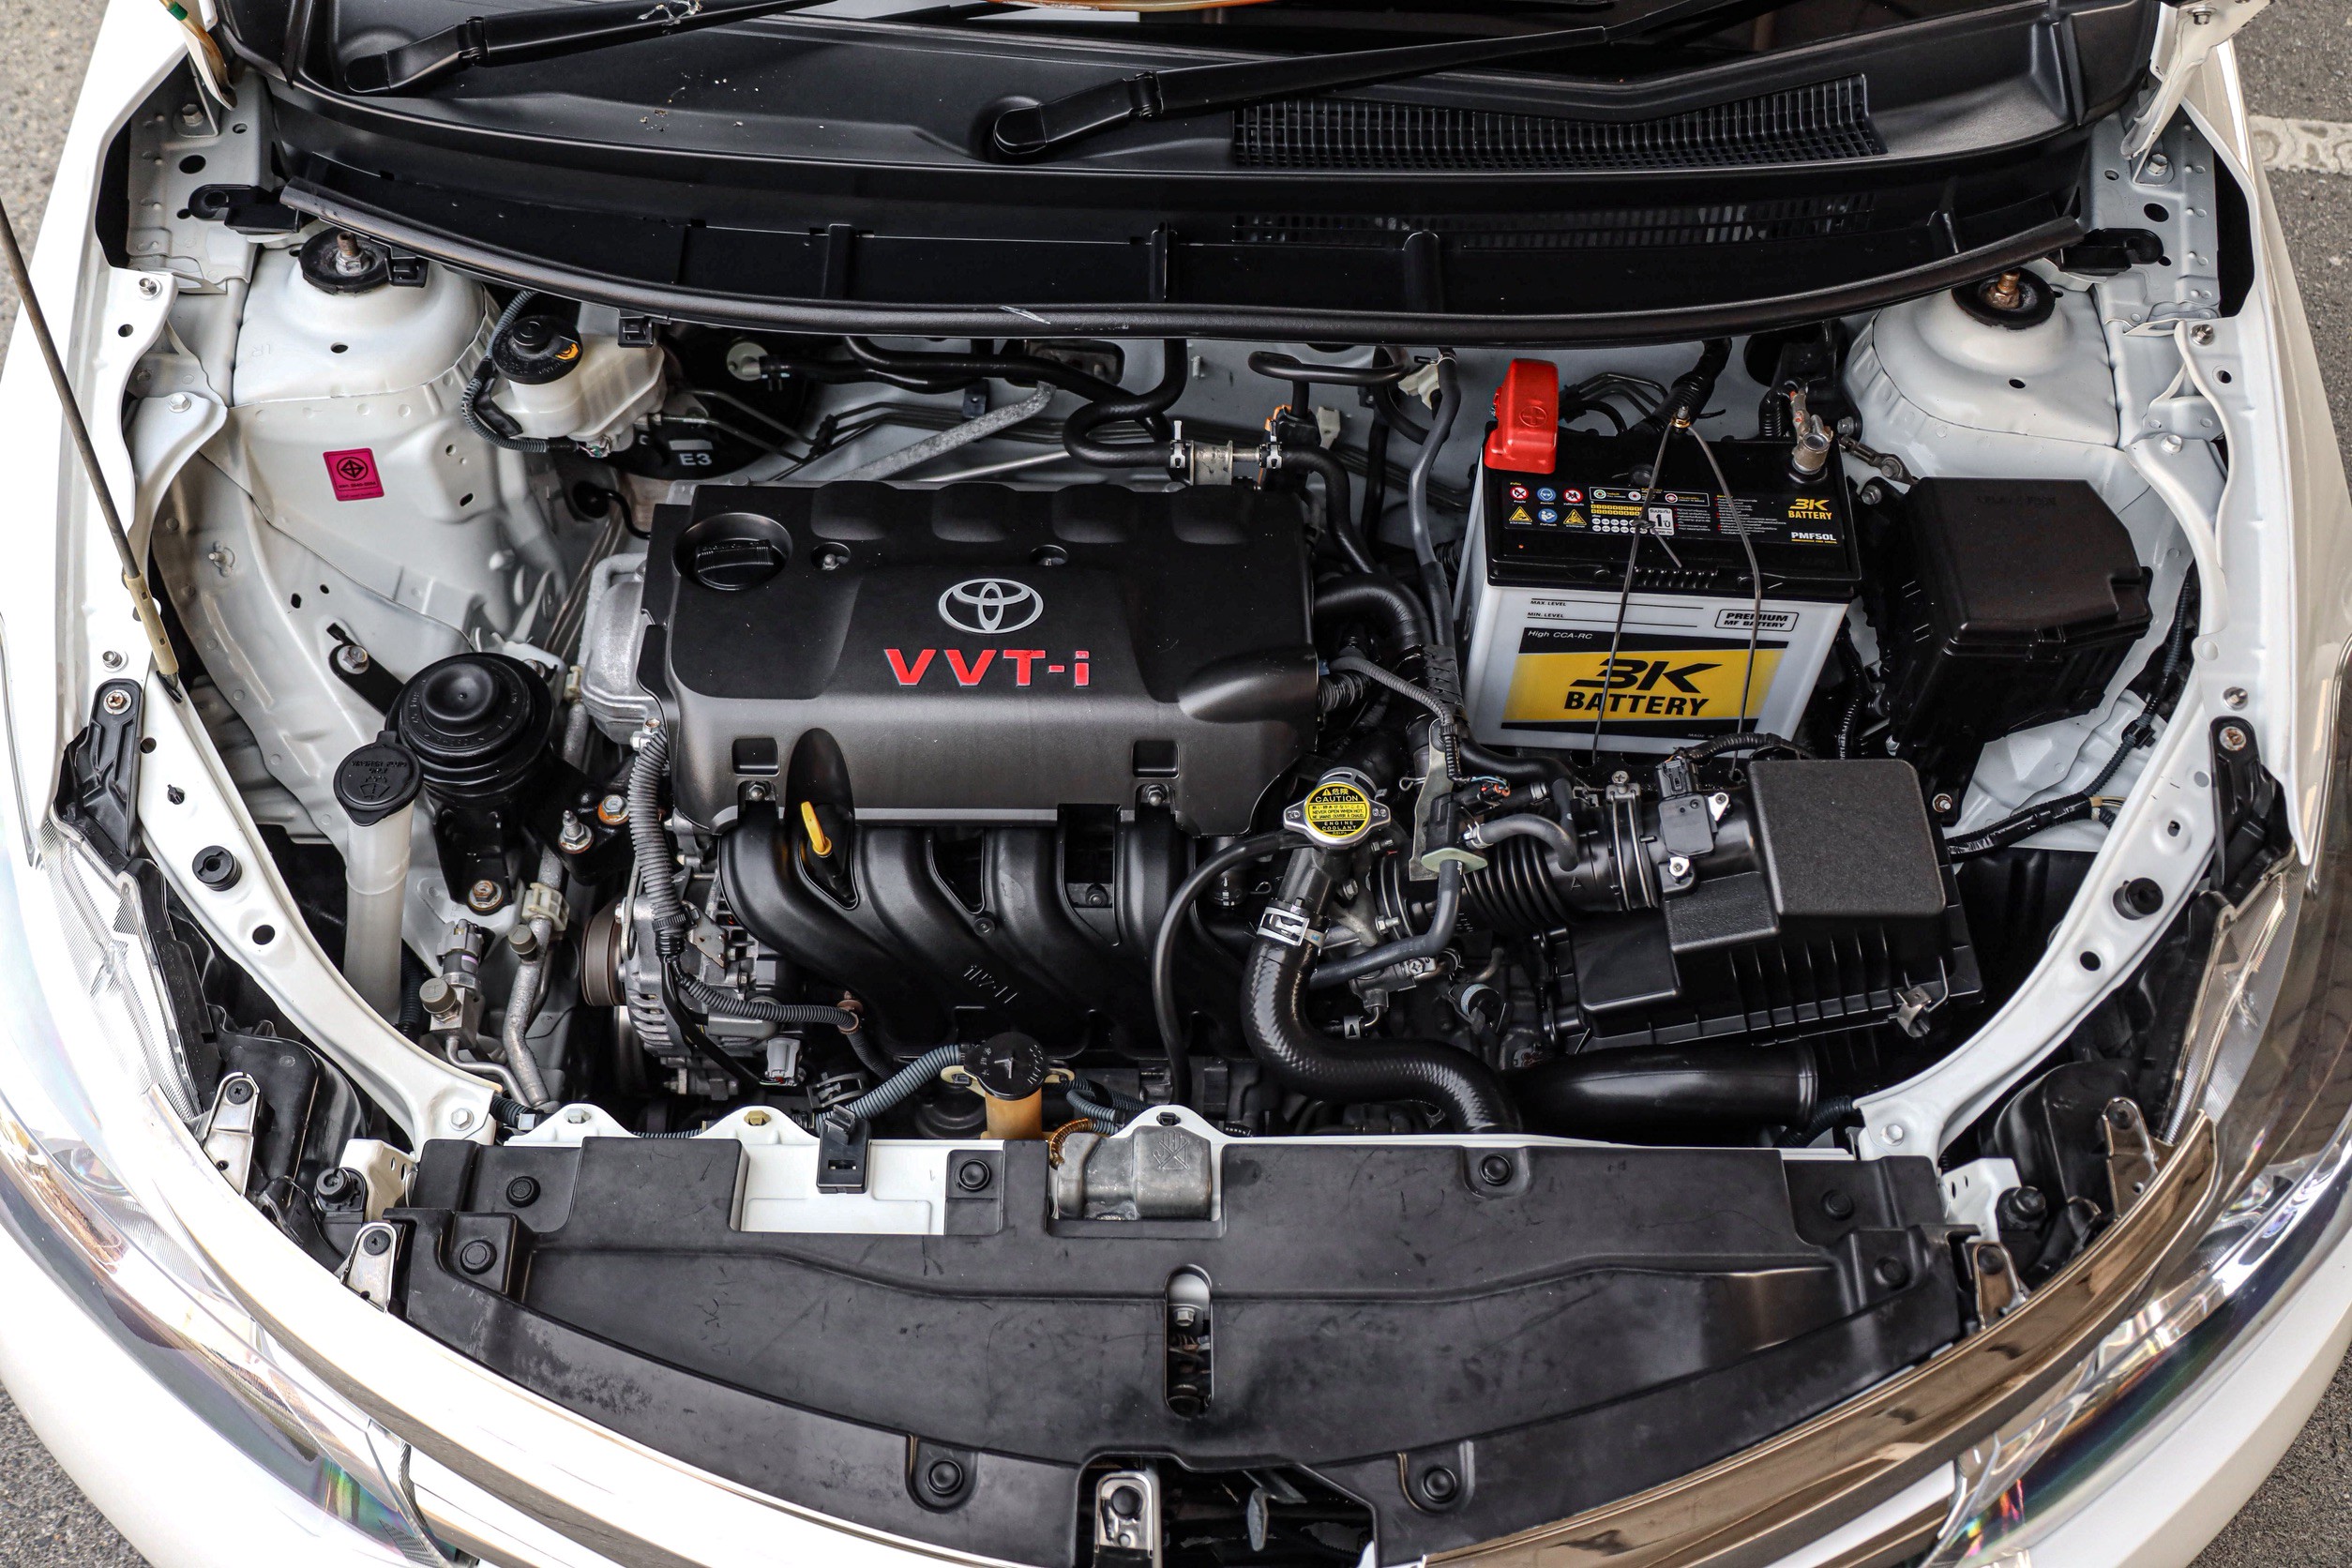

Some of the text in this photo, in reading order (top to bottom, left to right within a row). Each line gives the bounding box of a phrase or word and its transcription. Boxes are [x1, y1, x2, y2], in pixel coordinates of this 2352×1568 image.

[679, 453, 713, 466] E3
[1789, 498, 1830, 511] 3K
[1787, 510, 1832, 520] BATTERY
[1553, 631, 1593, 640] CCA-RC
[883, 648, 1090, 687] VVT-i
[1569, 658, 1724, 693] 3K
[1563, 691, 1710, 716] BATTERY
